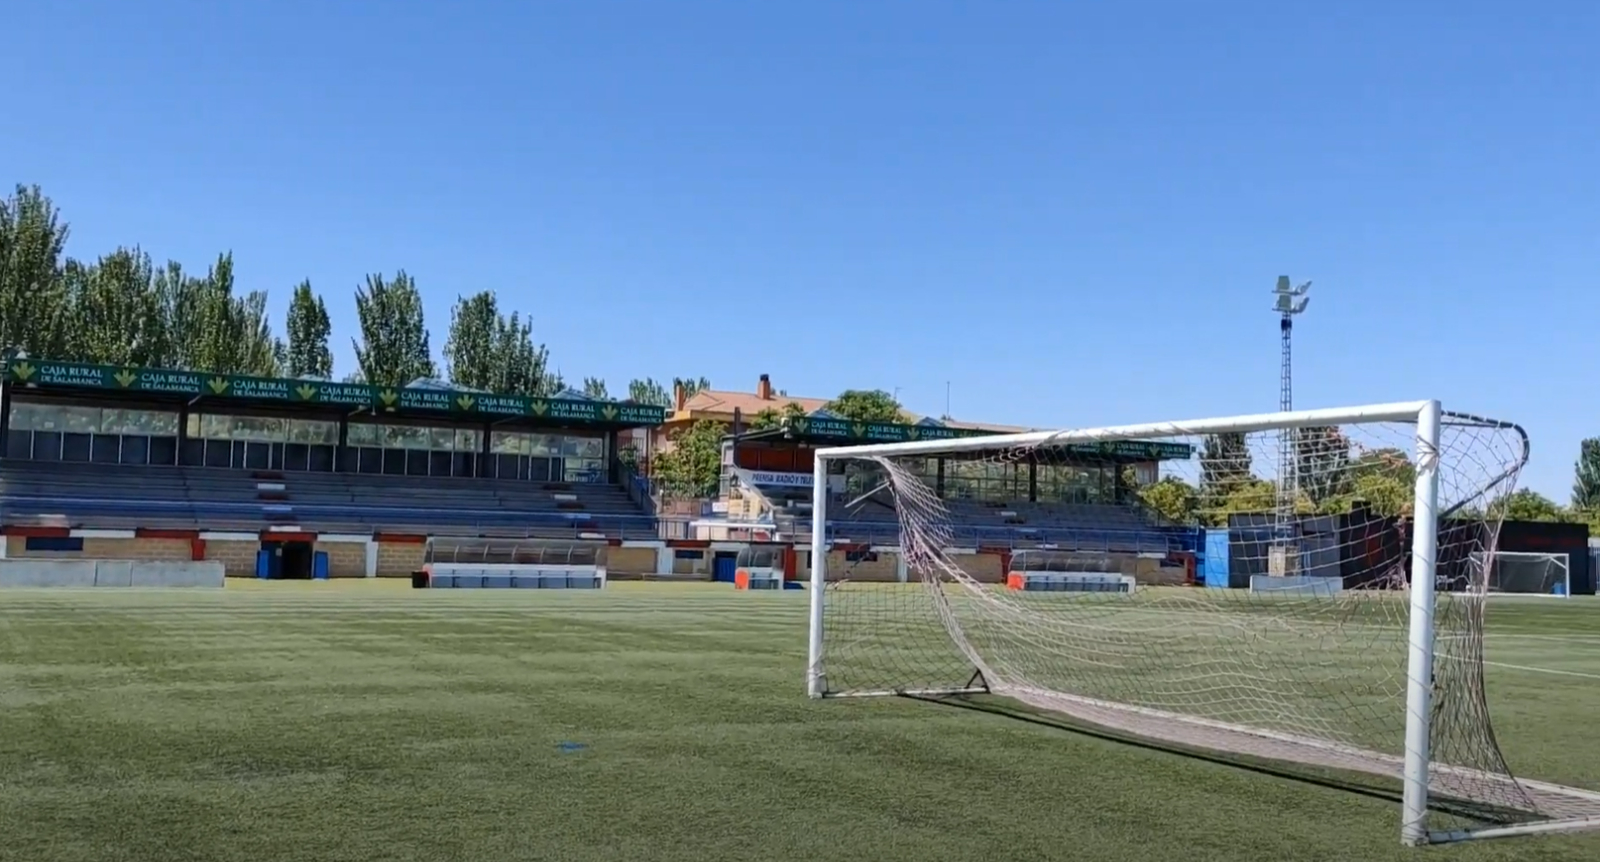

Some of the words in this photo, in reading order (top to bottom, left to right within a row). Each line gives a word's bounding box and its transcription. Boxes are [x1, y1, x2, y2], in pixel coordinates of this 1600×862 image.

[41, 366, 66, 377] CAJA
[69, 367, 103, 377] RURAL
[53, 376, 102, 385] SALAMANCA
[141, 373, 165, 384] CAJA
[168, 375, 200, 385] RURAL
[153, 383, 199, 392] SALAMANCA
[233, 380, 256, 390] CAJA
[258, 381, 288, 391] RURAL
[320, 386, 341, 396] CAJA
[343, 387, 371, 396] RURAL
[401, 391, 421, 401] CAJA
[423, 393, 449, 402] RURAL
[478, 397, 498, 406] CAJA
[500, 398, 524, 407] RURAL
[551, 402, 570, 411] CAJA
[571, 403, 595, 412] RURAL
[620, 407, 638, 416] CAJA
[640, 409, 662, 417] RURAL
[752, 473, 773, 482] PRENSA
